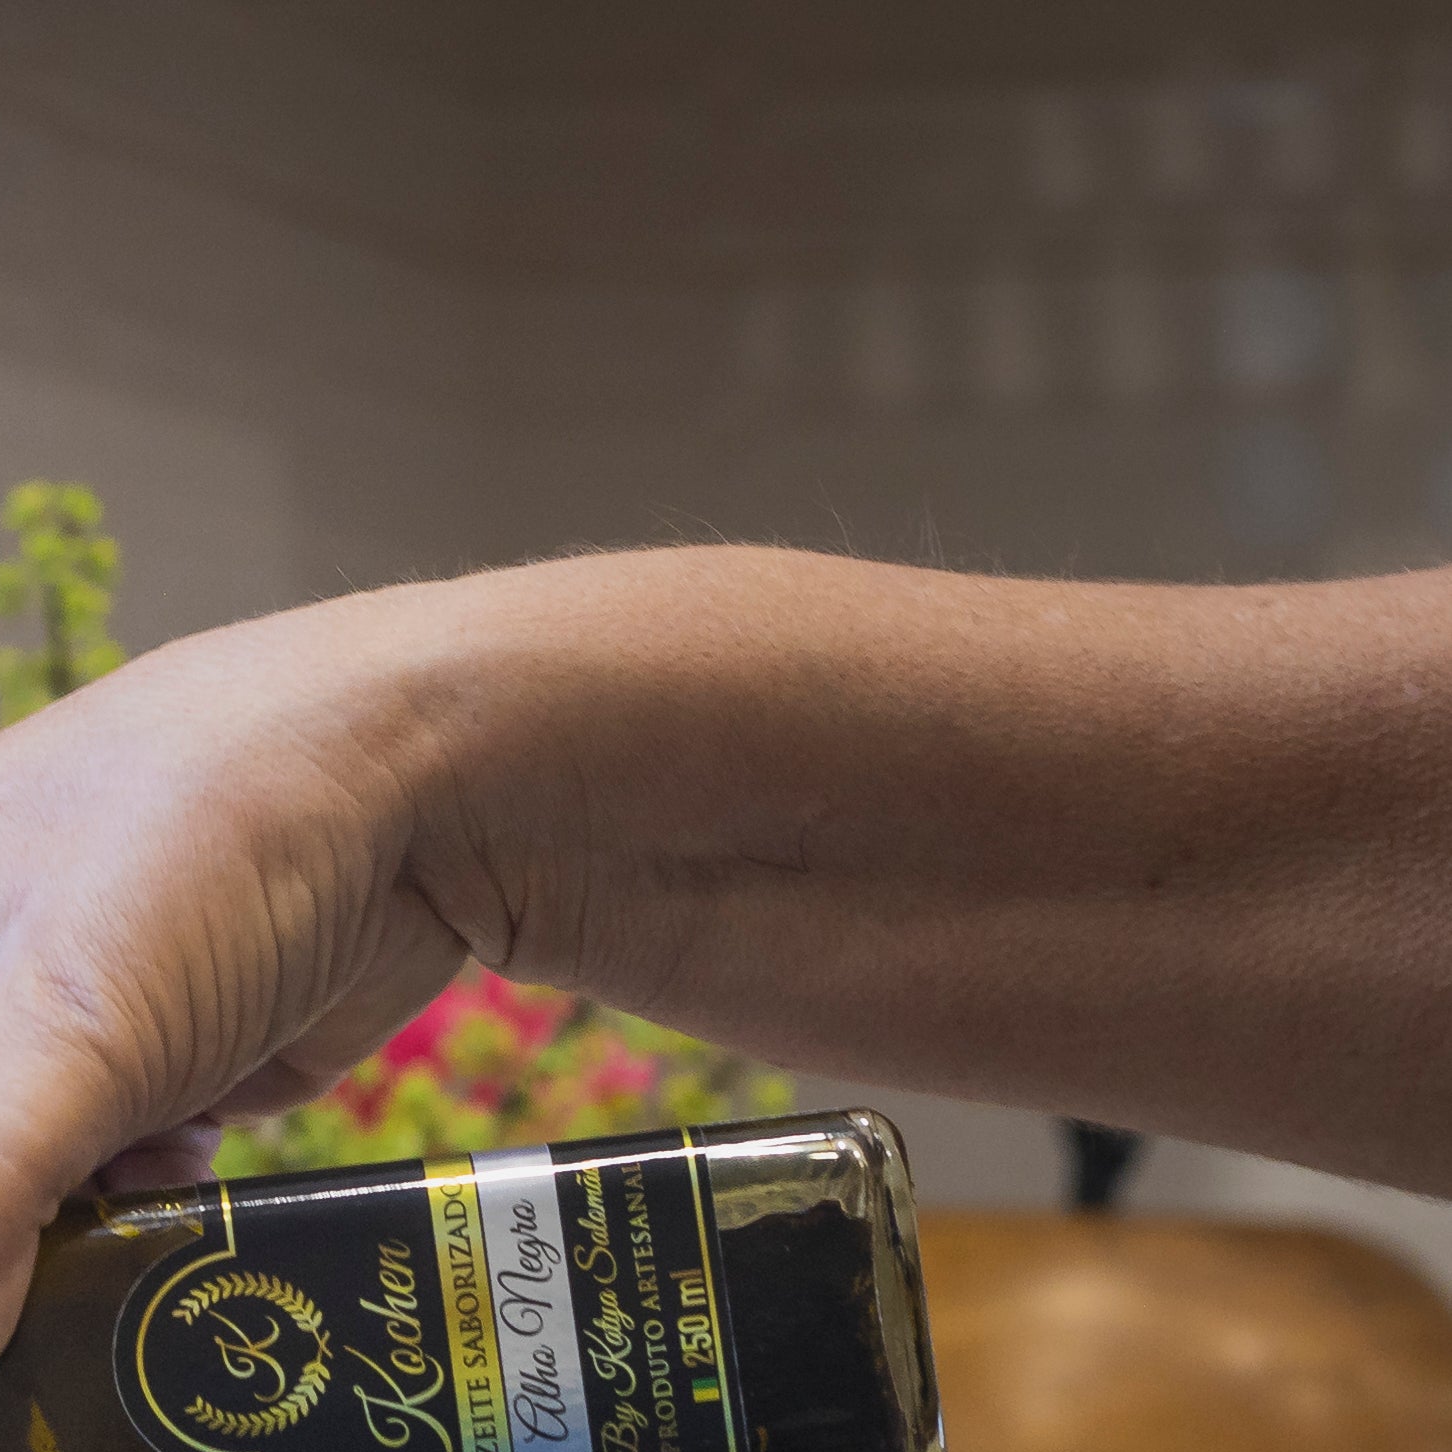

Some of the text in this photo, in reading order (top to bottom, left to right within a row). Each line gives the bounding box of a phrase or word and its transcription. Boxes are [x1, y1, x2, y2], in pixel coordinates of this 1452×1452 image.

[440, 1182, 488, 1370] SABORIZADO
[621, 1161, 661, 1313] ARTESANAL
[207, 1310, 286, 1402] K
[497, 1198, 569, 1444] Alho Negro
[583, 1288, 638, 1398] Katya
[669, 1268, 715, 1369] 250 ml
